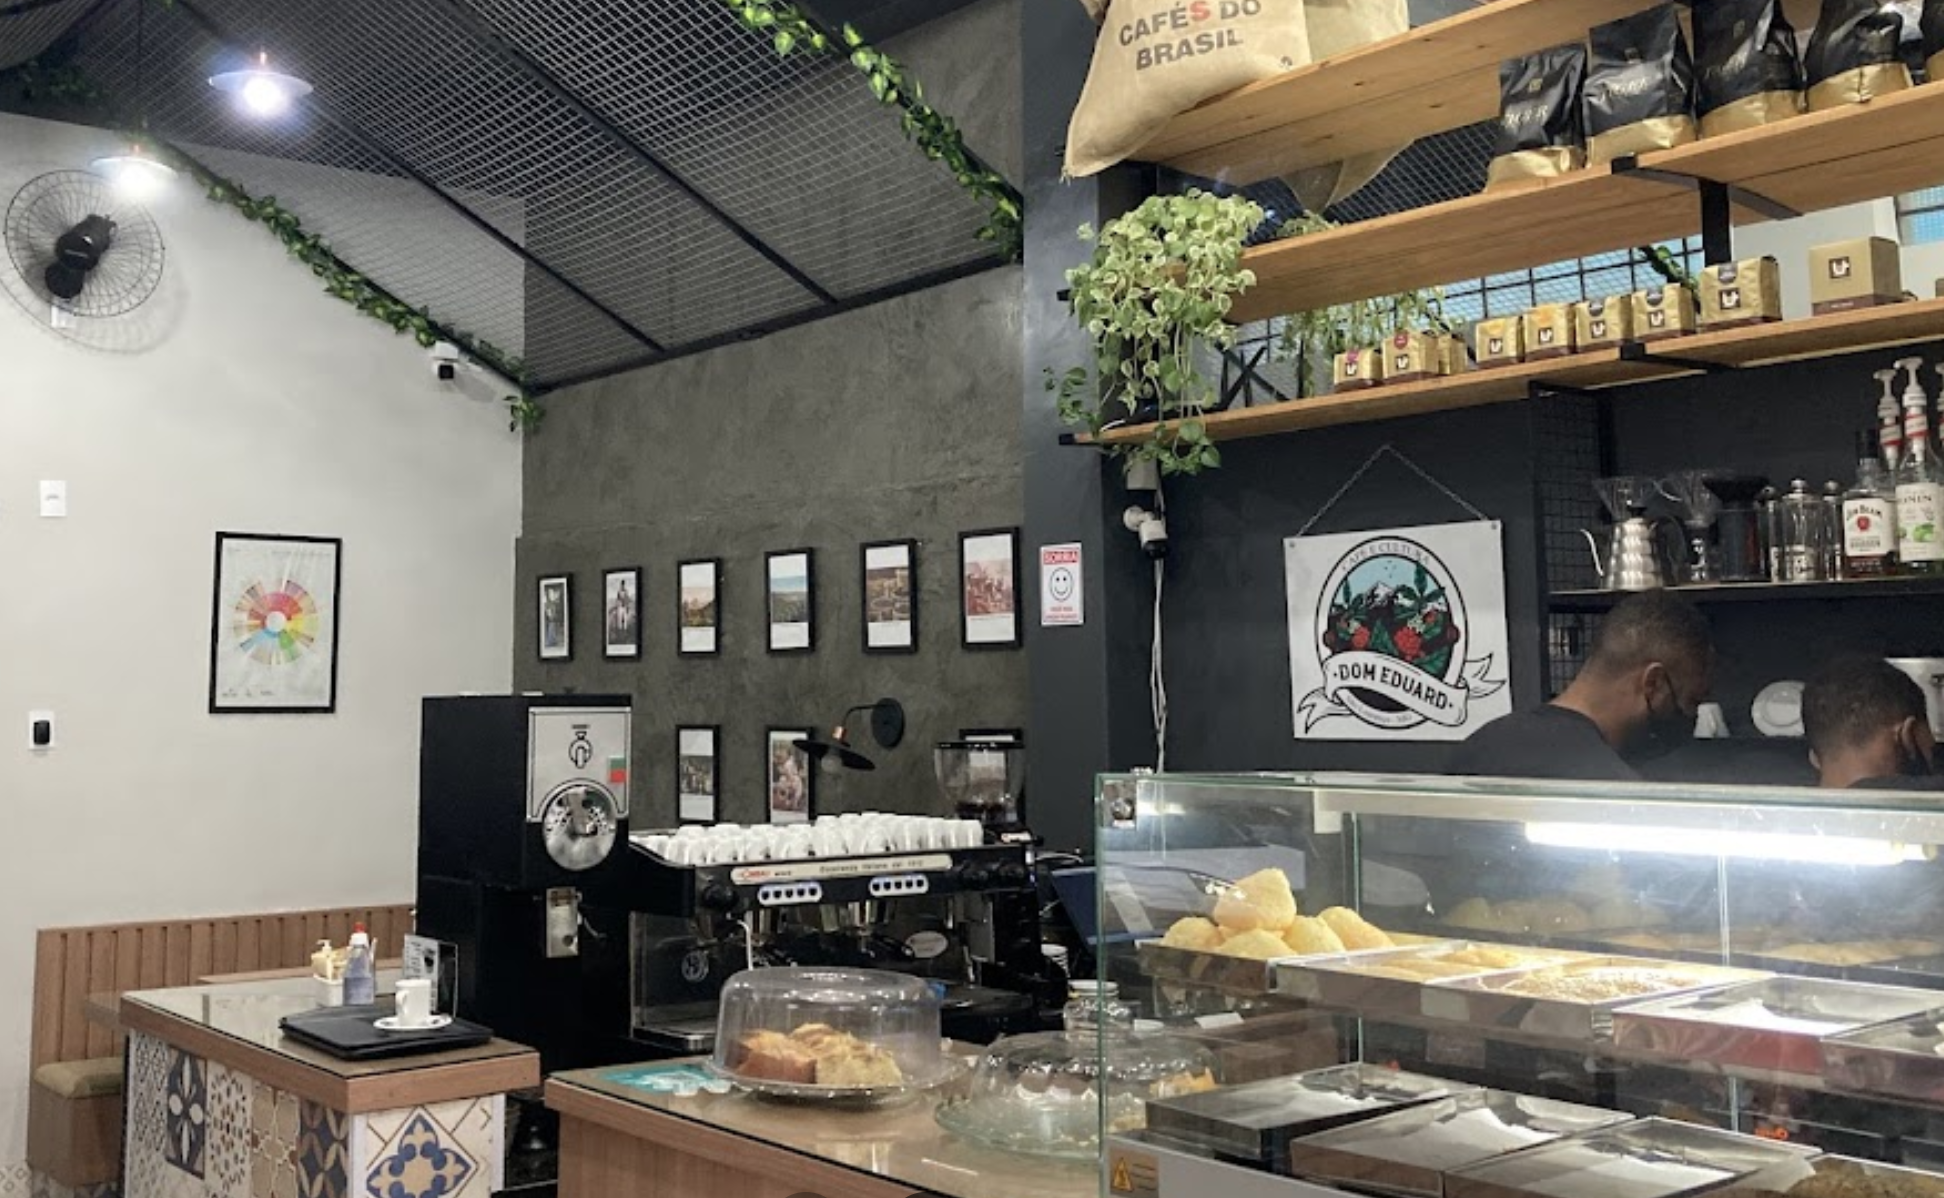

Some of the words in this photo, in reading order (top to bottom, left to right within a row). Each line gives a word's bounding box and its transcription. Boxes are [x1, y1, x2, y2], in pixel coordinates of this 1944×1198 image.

[1119, 1, 1211, 46] CAFÉS
[1220, 0, 1261, 19] DO
[1135, 29, 1243, 70] BRASIL
[1338, 662, 1376, 681] DOM
[1380, 666, 1448, 709] EDUARD
